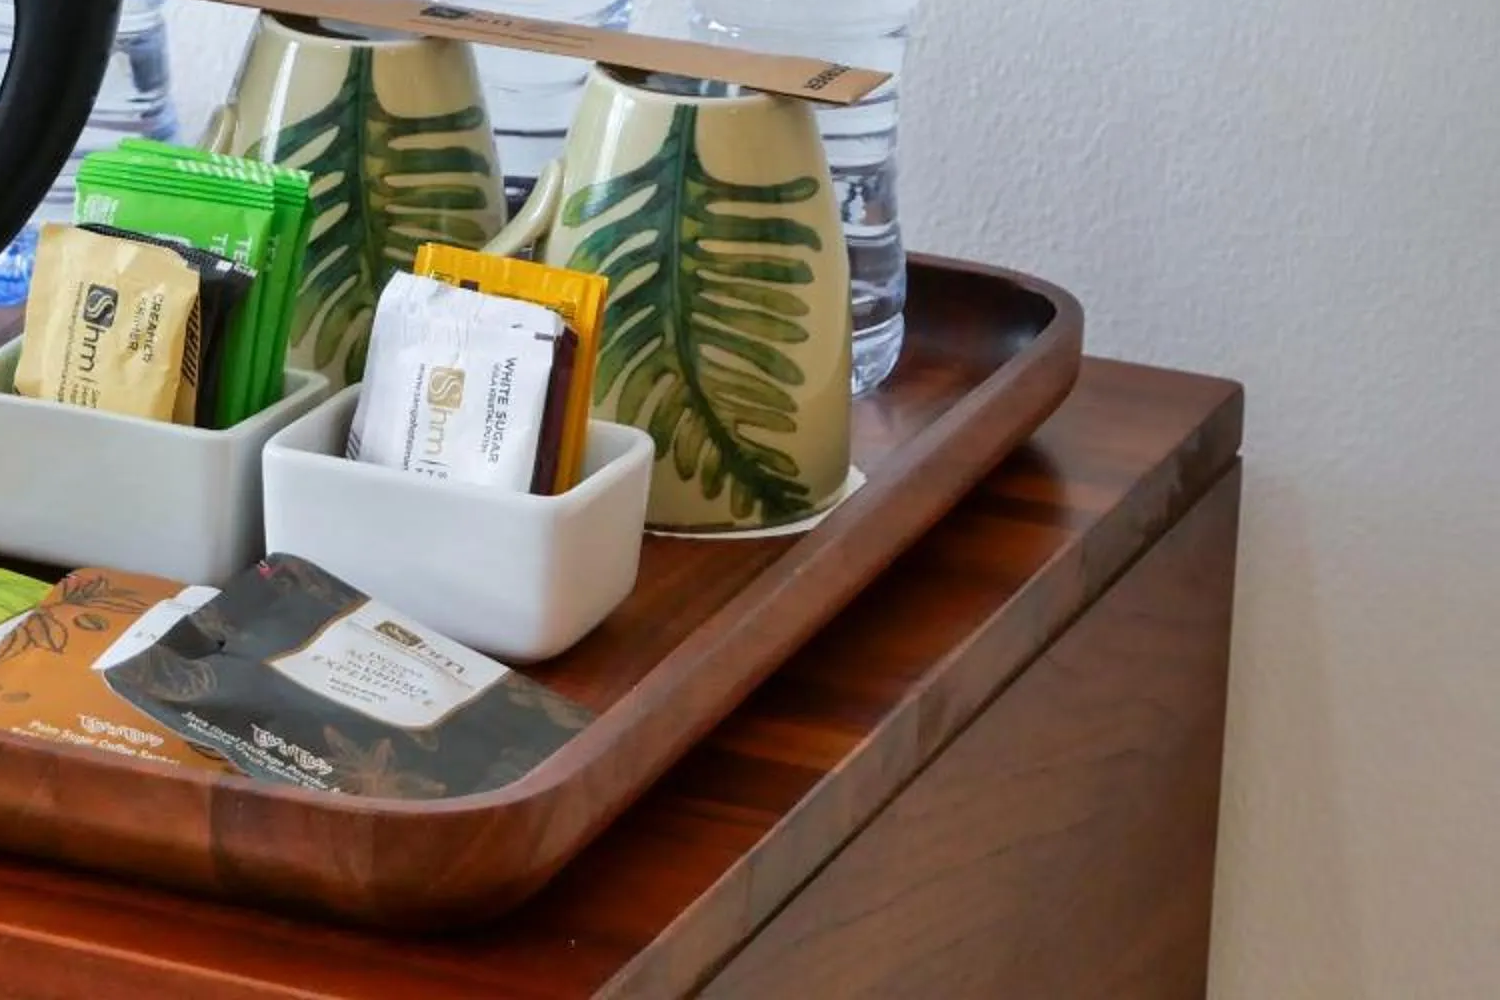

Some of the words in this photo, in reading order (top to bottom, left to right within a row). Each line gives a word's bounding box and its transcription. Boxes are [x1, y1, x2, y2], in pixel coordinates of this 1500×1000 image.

[143, 291, 165, 365] CREAMER
[502, 356, 518, 406] WHITE
[487, 410, 508, 464] SUGAR
